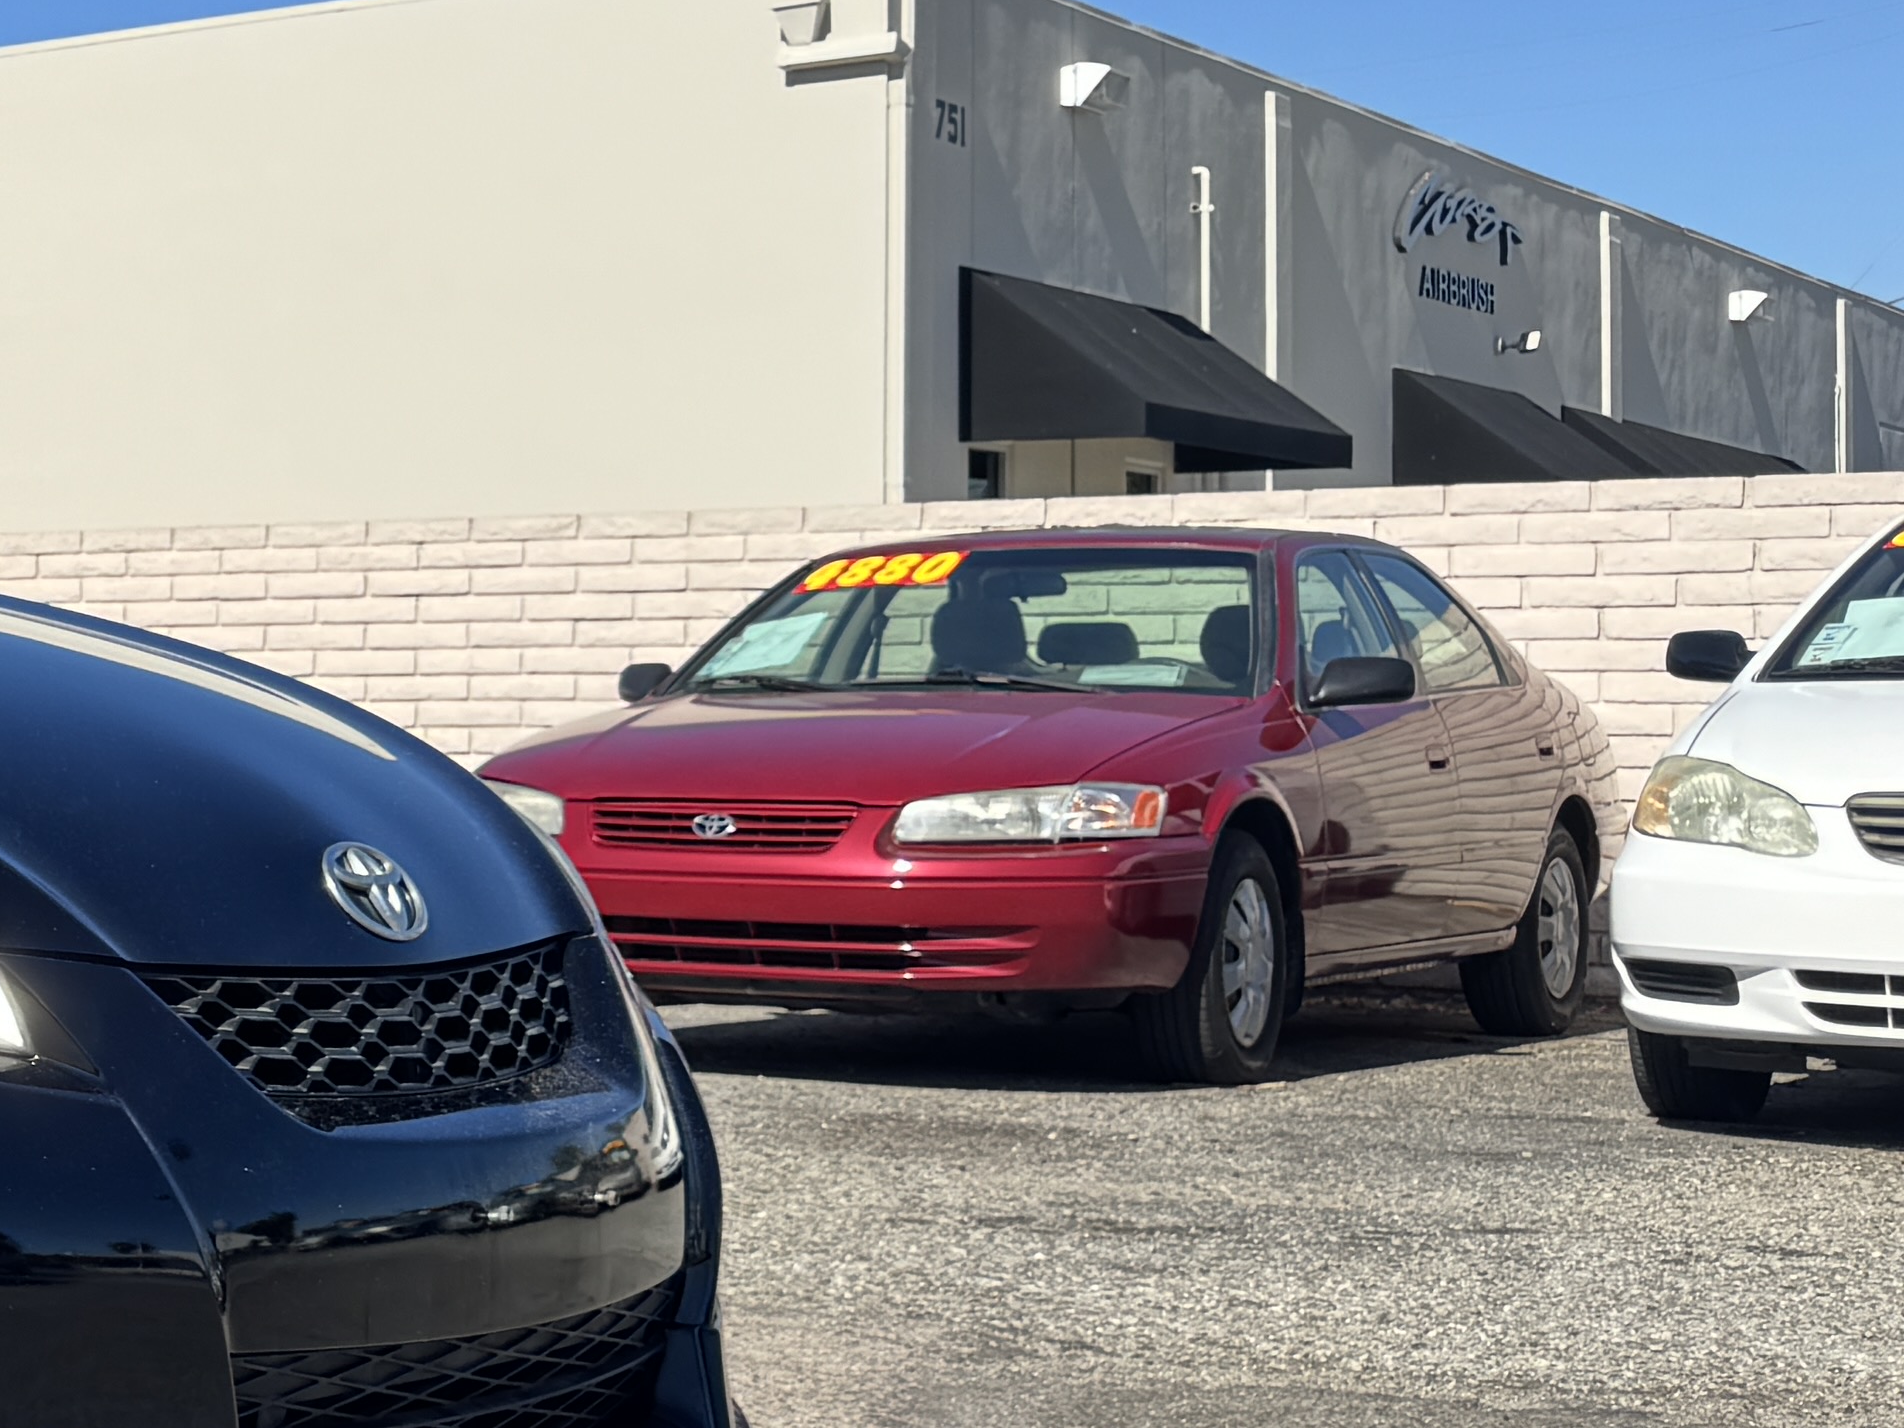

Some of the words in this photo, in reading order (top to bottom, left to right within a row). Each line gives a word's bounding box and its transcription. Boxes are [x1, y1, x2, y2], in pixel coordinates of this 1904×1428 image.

[935, 98, 966, 147] 751
[1419, 265, 1495, 315] AIRBRUSH
[803, 550, 964, 592] 4880
